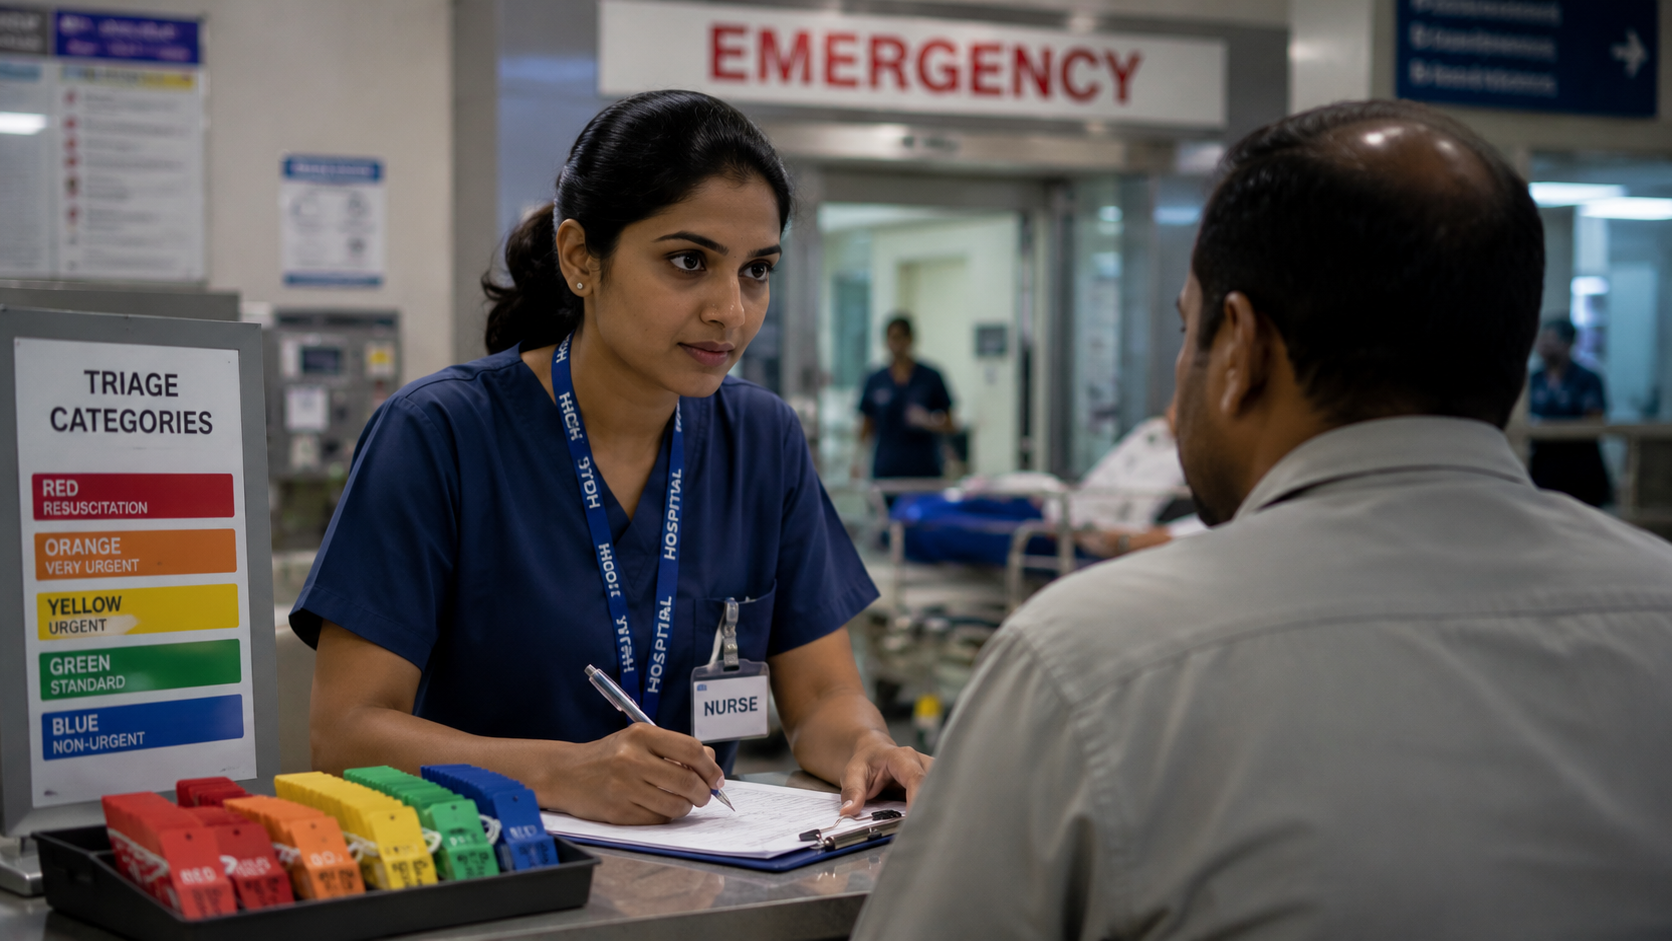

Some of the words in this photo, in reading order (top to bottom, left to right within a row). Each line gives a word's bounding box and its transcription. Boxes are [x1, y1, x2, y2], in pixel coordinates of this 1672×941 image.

[708, 23, 1143, 105] EMERGENCY
[84, 369, 178, 397] TRIAGE
[50, 406, 213, 435] CATEGORIES
[42, 480, 78, 498] RED
[43, 501, 149, 516] RESUSCITATION
[44, 537, 121, 557] ORANGE
[45, 559, 82, 575] VERY
[85, 558, 140, 574] URGENT
[47, 595, 122, 616] YELLOW
[48, 618, 107, 636] URGENT
[49, 655, 111, 675] GREEN
[50, 676, 126, 695] STANDARD
[704, 696, 758, 716] NURSE
[52, 714, 99, 736] BLUE
[53, 732, 145, 754] NON-URGENT
